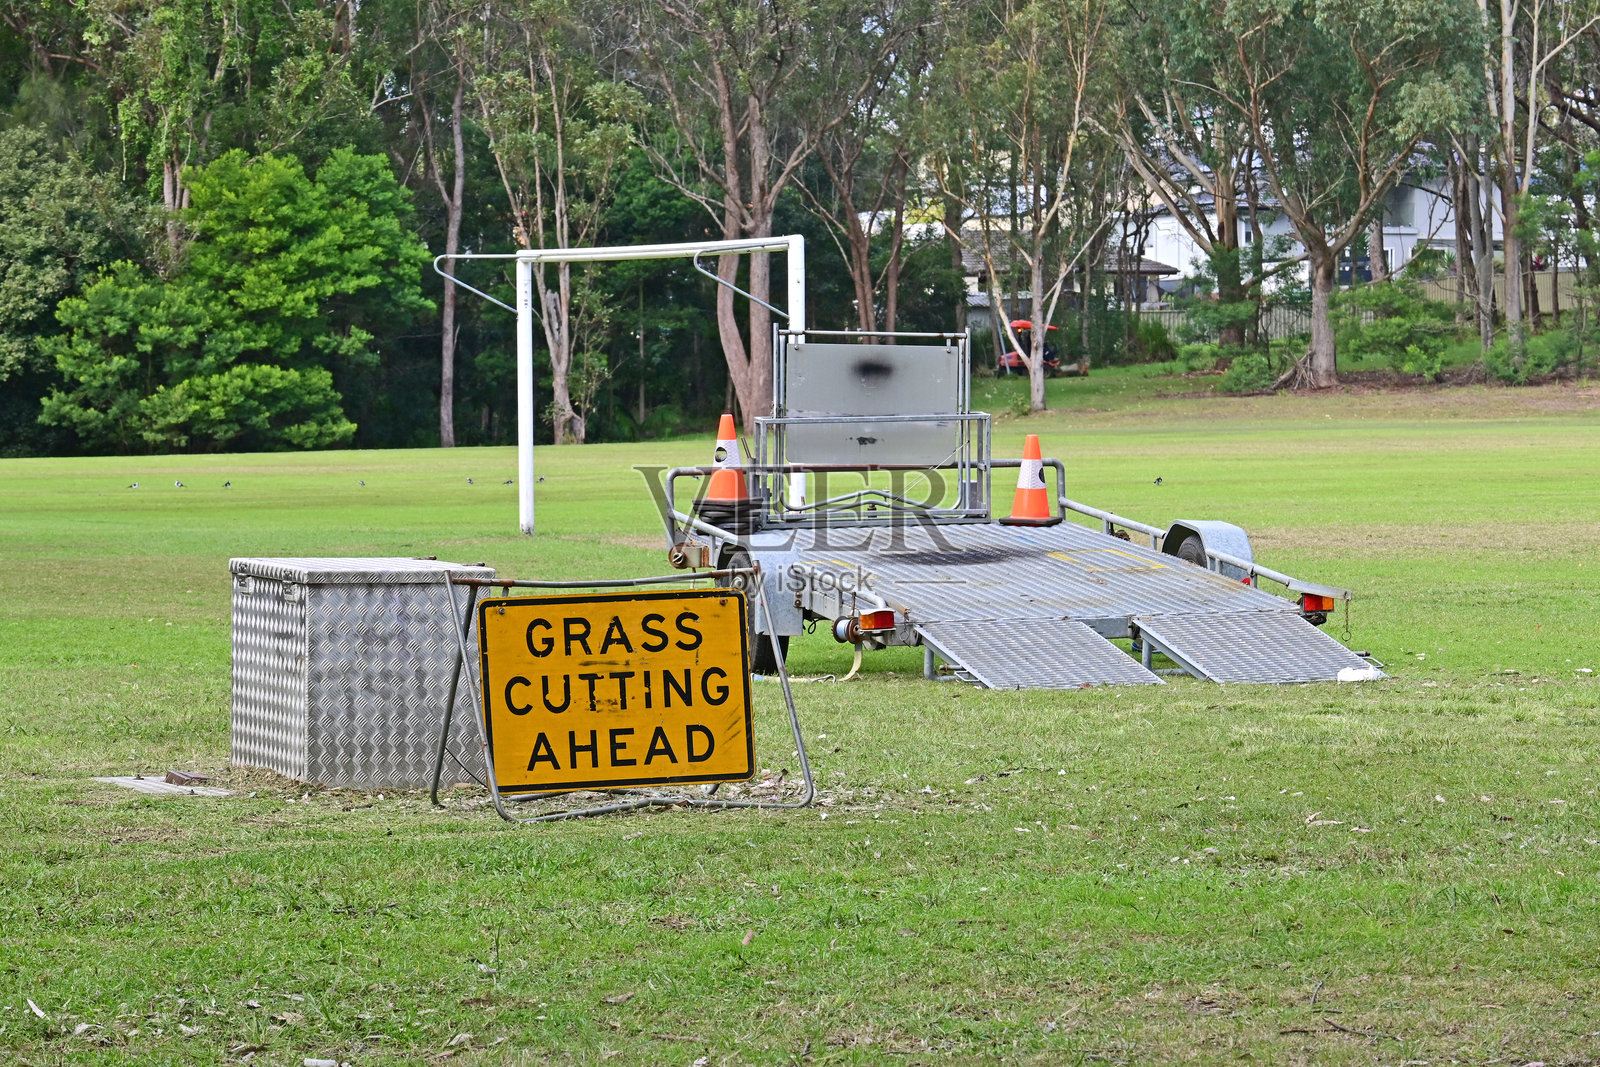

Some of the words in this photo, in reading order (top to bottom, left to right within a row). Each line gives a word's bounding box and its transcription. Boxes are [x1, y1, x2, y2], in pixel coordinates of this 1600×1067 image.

[526, 612, 702, 657] GRASS
[504, 667, 729, 715] CUTTING
[527, 724, 715, 771] AHEAD
